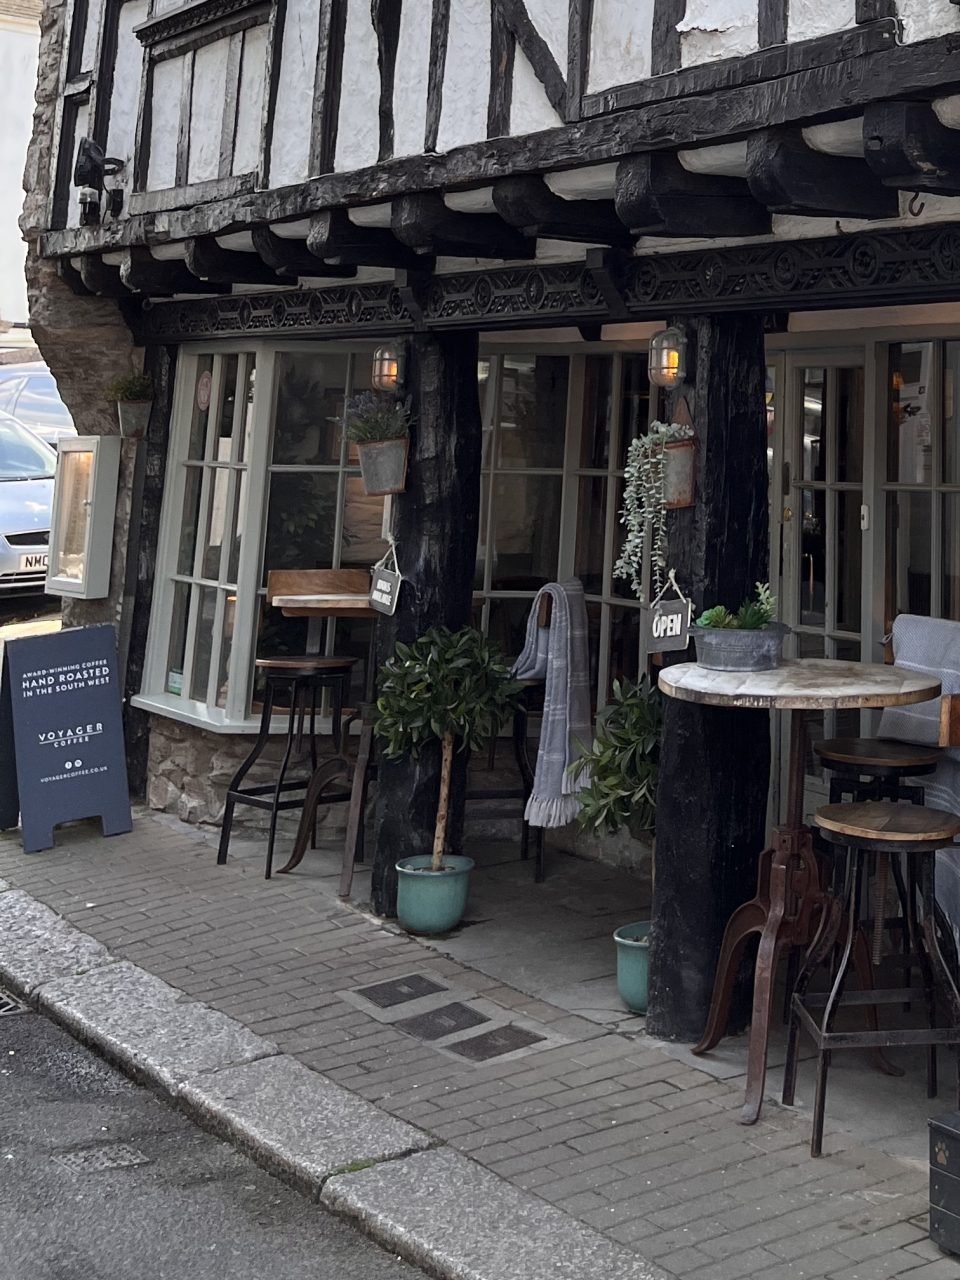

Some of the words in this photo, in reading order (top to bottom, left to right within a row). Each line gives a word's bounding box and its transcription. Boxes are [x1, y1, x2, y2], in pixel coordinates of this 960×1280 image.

[652, 613, 682, 638] OPEN
[22, 664, 80, 678] AWARD-WINNING
[81, 659, 107, 668] COFFEE
[22, 676, 55, 689] HAND
[59, 667, 110, 682] ROASTED
[23, 690, 33, 698] IN
[36, 686, 52, 695] THE
[55, 681, 85, 692] SOUTH
[87, 676, 110, 686] WEST
[38, 722, 103, 741] VOYAGER
[53, 736, 89, 748] COFFEE
